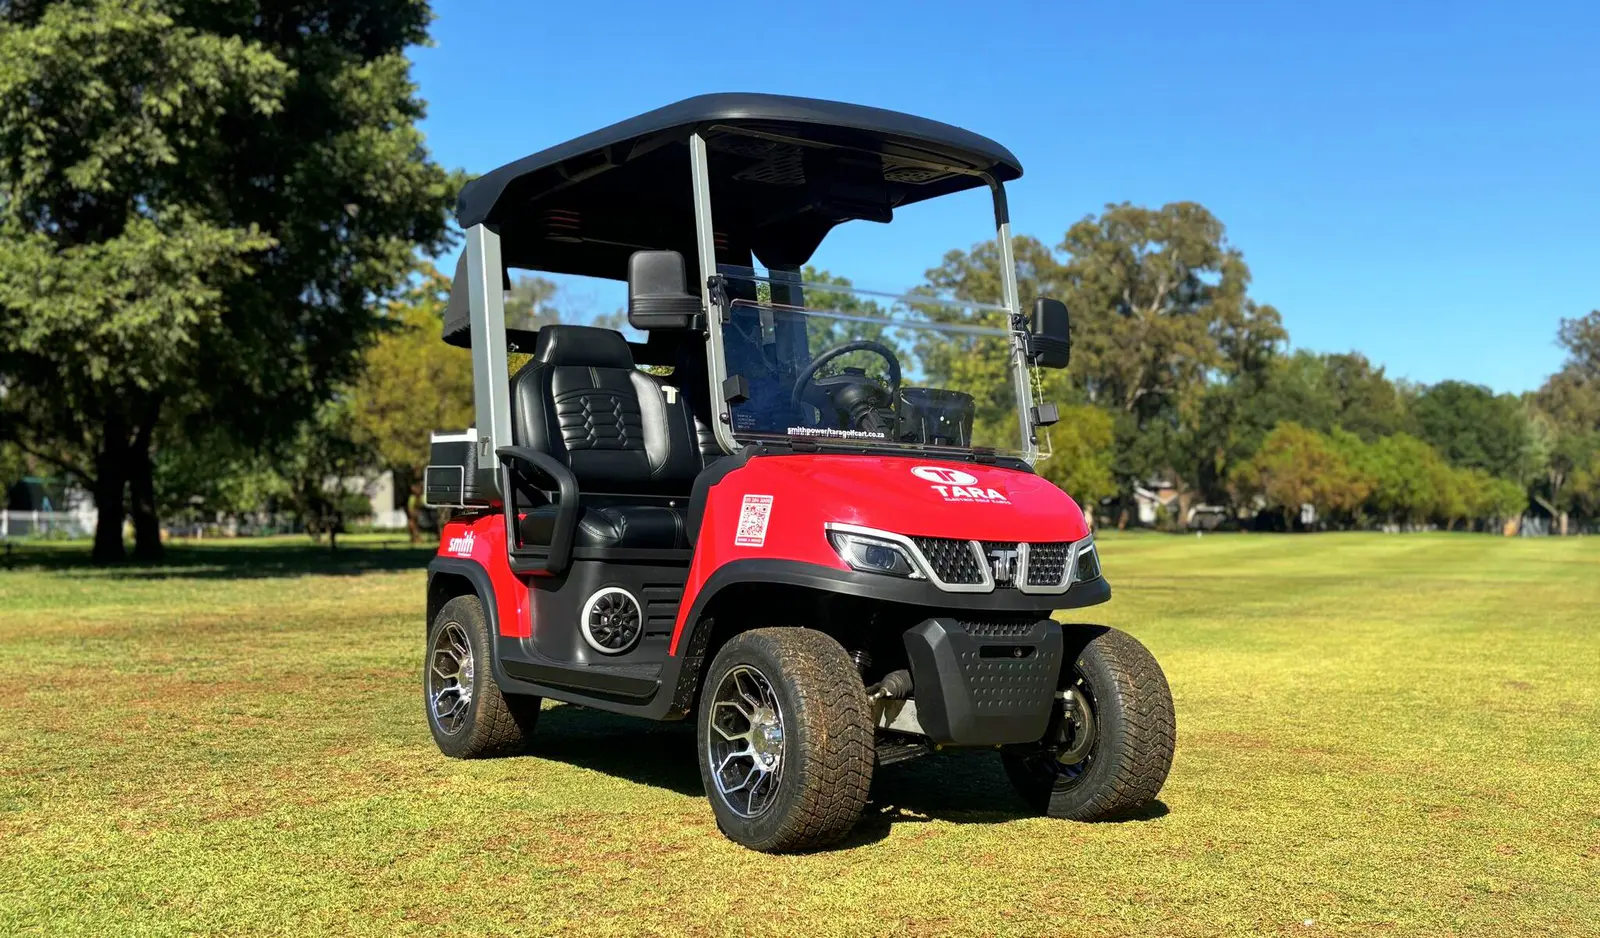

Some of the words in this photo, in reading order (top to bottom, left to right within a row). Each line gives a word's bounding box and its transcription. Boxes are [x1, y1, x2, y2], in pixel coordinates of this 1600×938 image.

[787, 425, 885, 439] smithpower/taragolfcart.co.za
[931, 485, 1007, 501] TARA
[448, 530, 474, 553] smith
